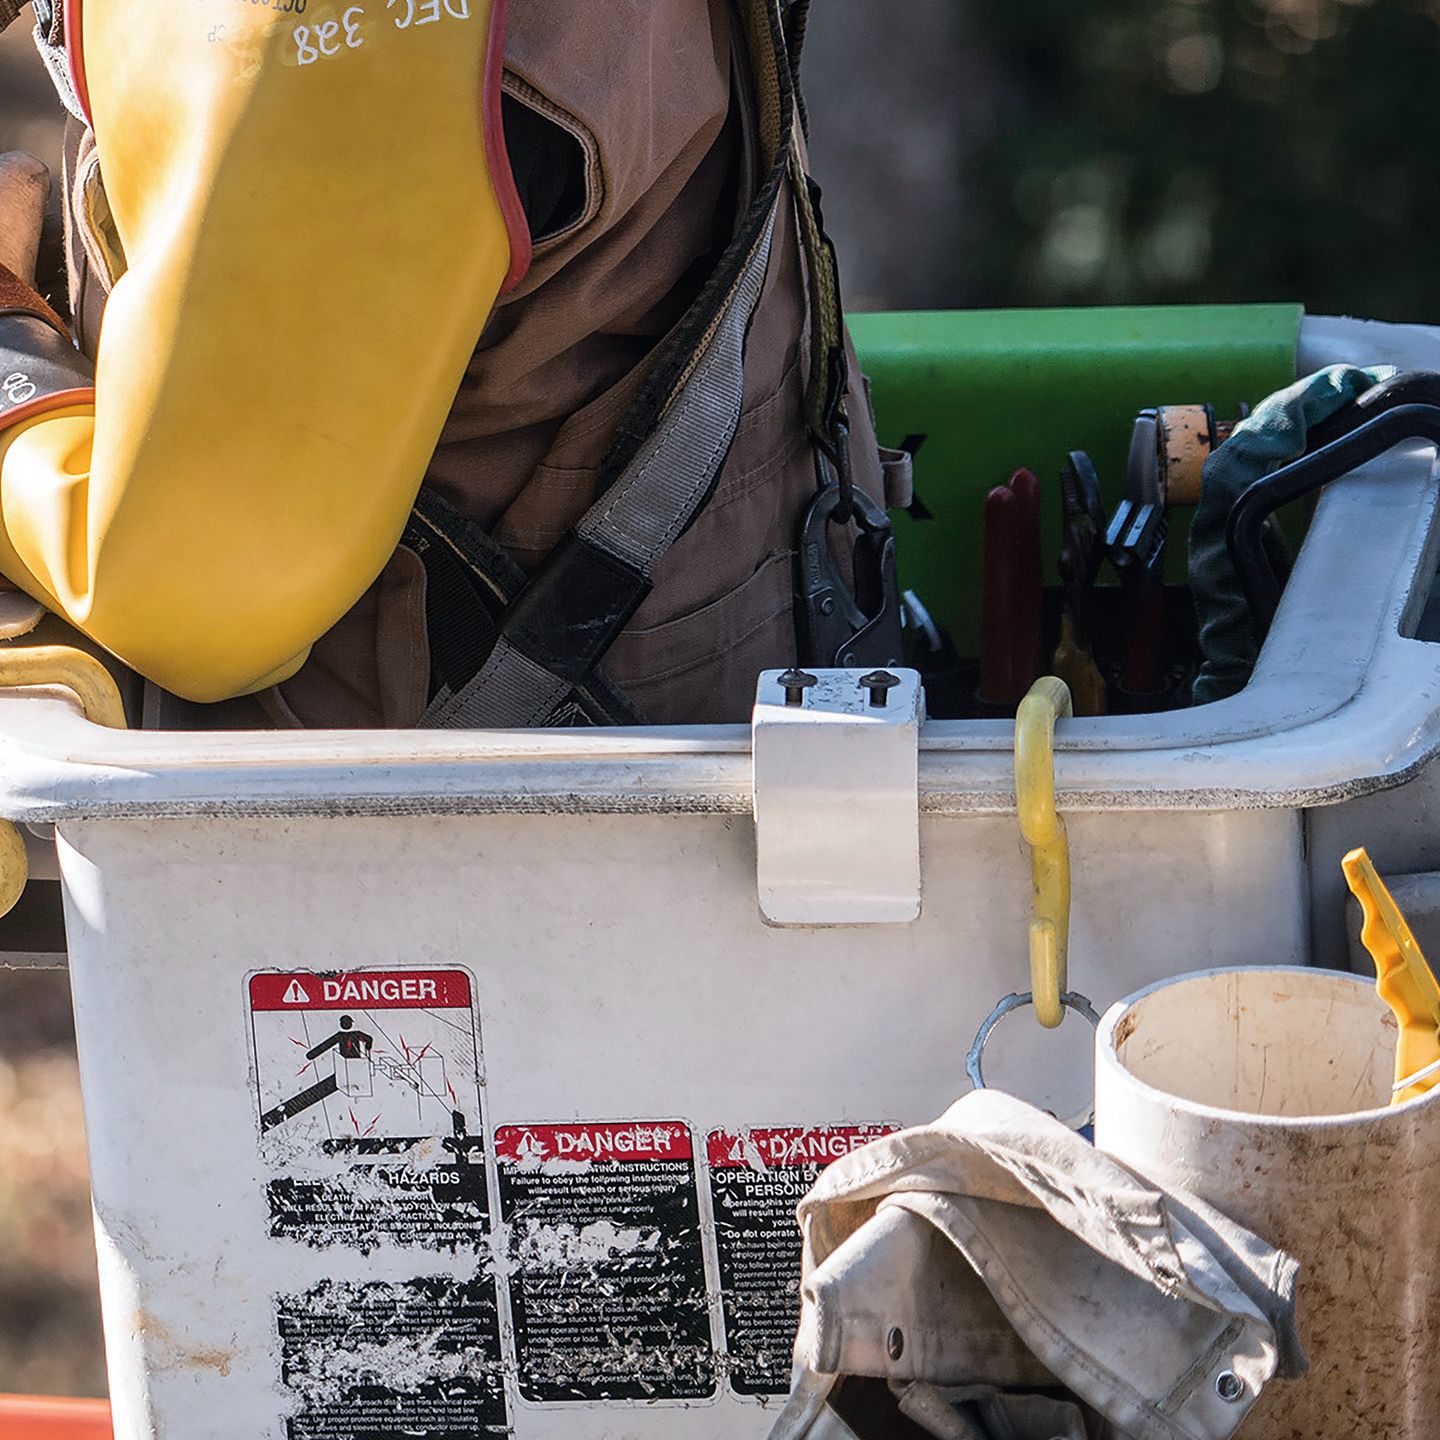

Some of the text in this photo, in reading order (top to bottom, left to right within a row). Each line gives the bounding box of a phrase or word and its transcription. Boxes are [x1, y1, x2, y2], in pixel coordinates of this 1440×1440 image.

[293, 6, 364, 65] 328
[323, 978, 437, 1001] DANGER
[558, 1130, 672, 1153] DANGER
[770, 1134, 887, 1158] DANGE
[619, 1163, 688, 1173] INSTRUCTIONS
[389, 1172, 460, 1184] HAZARDS
[510, 1177, 540, 1185] Failure
[552, 1177, 573, 1185] obey
[575, 1176, 589, 1184] the
[591, 1175, 630, 1184] following
[632, 1174, 681, 1182] instruction
[716, 1170, 800, 1184] OPERATION
[305, 1203, 336, 1212] RESUL
[399, 1212, 442, 1221] PRACTICE
[732, 1209, 747, 1217] will
[727, 1230, 740, 1238] Do
[760, 1229, 795, 1239] operate
[733, 1262, 748, 1270] You
[733, 1271, 777, 1280] government
[734, 1280, 776, 1288] instructions
[744, 1378, 773, 1386] wearing
